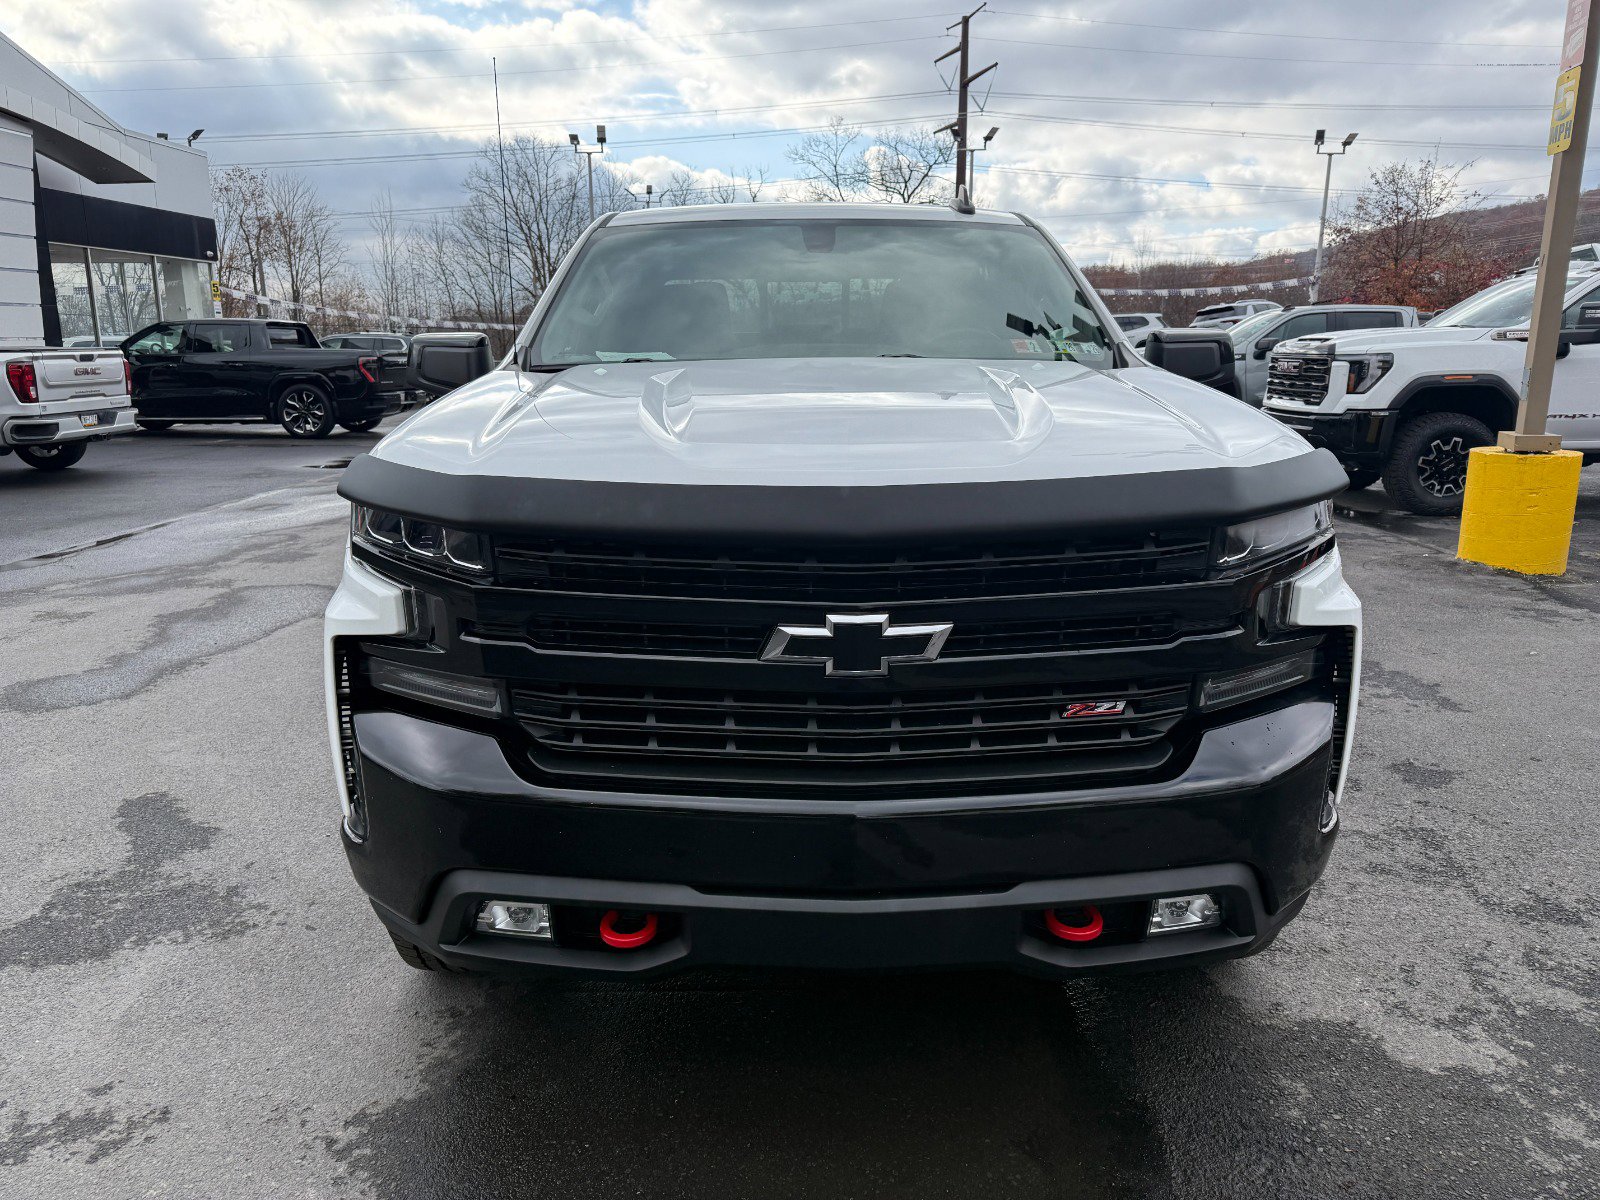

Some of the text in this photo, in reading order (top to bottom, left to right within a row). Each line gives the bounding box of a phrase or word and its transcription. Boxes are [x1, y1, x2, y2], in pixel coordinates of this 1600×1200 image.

[1555, 79, 1576, 122] 5
[1550, 119, 1573, 145] MPH
[212, 283, 219, 293] 5
[73, 366, 102, 376] GMC
[1277, 361, 1300, 373] GMC
[1062, 701, 1126, 718] Z71
